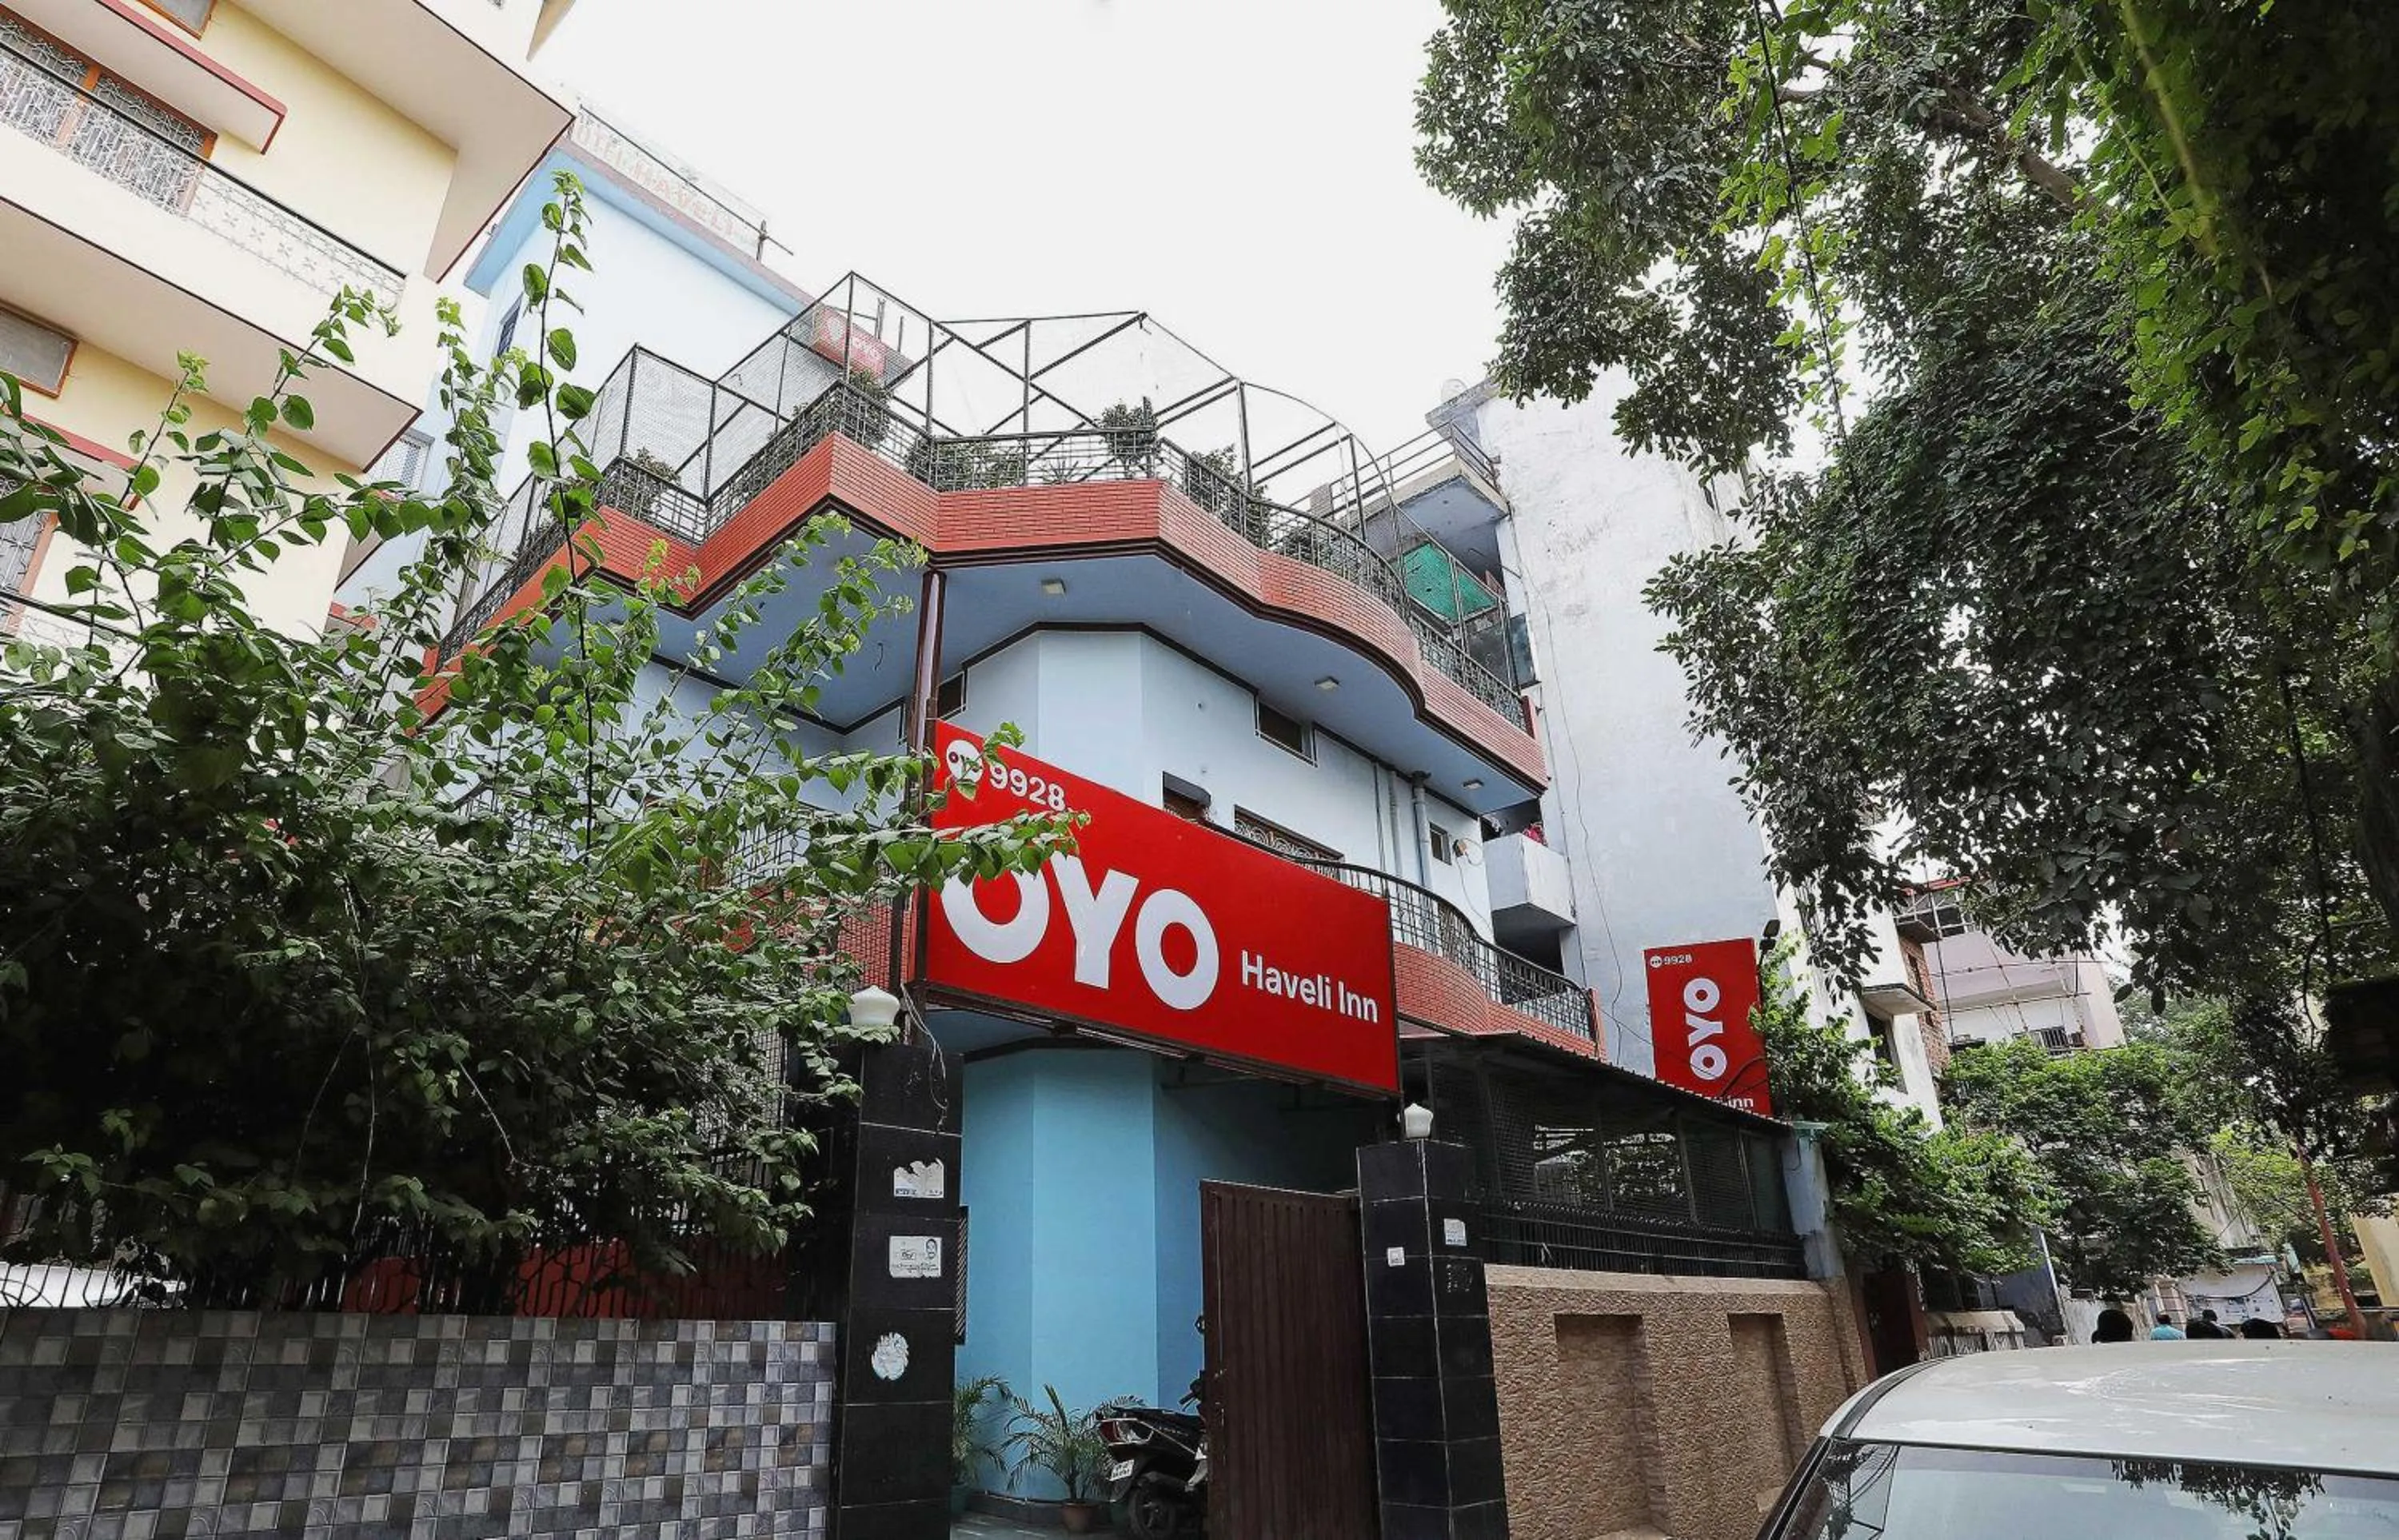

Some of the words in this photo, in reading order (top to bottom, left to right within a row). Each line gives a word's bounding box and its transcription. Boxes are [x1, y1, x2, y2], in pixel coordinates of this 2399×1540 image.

[989, 761, 1066, 812] 9928
[940, 850, 1219, 1010] OYO
[1242, 949, 1331, 1011] Haveli
[1338, 980, 1379, 1023] Inn
[1683, 977, 1727, 1080] OYO
